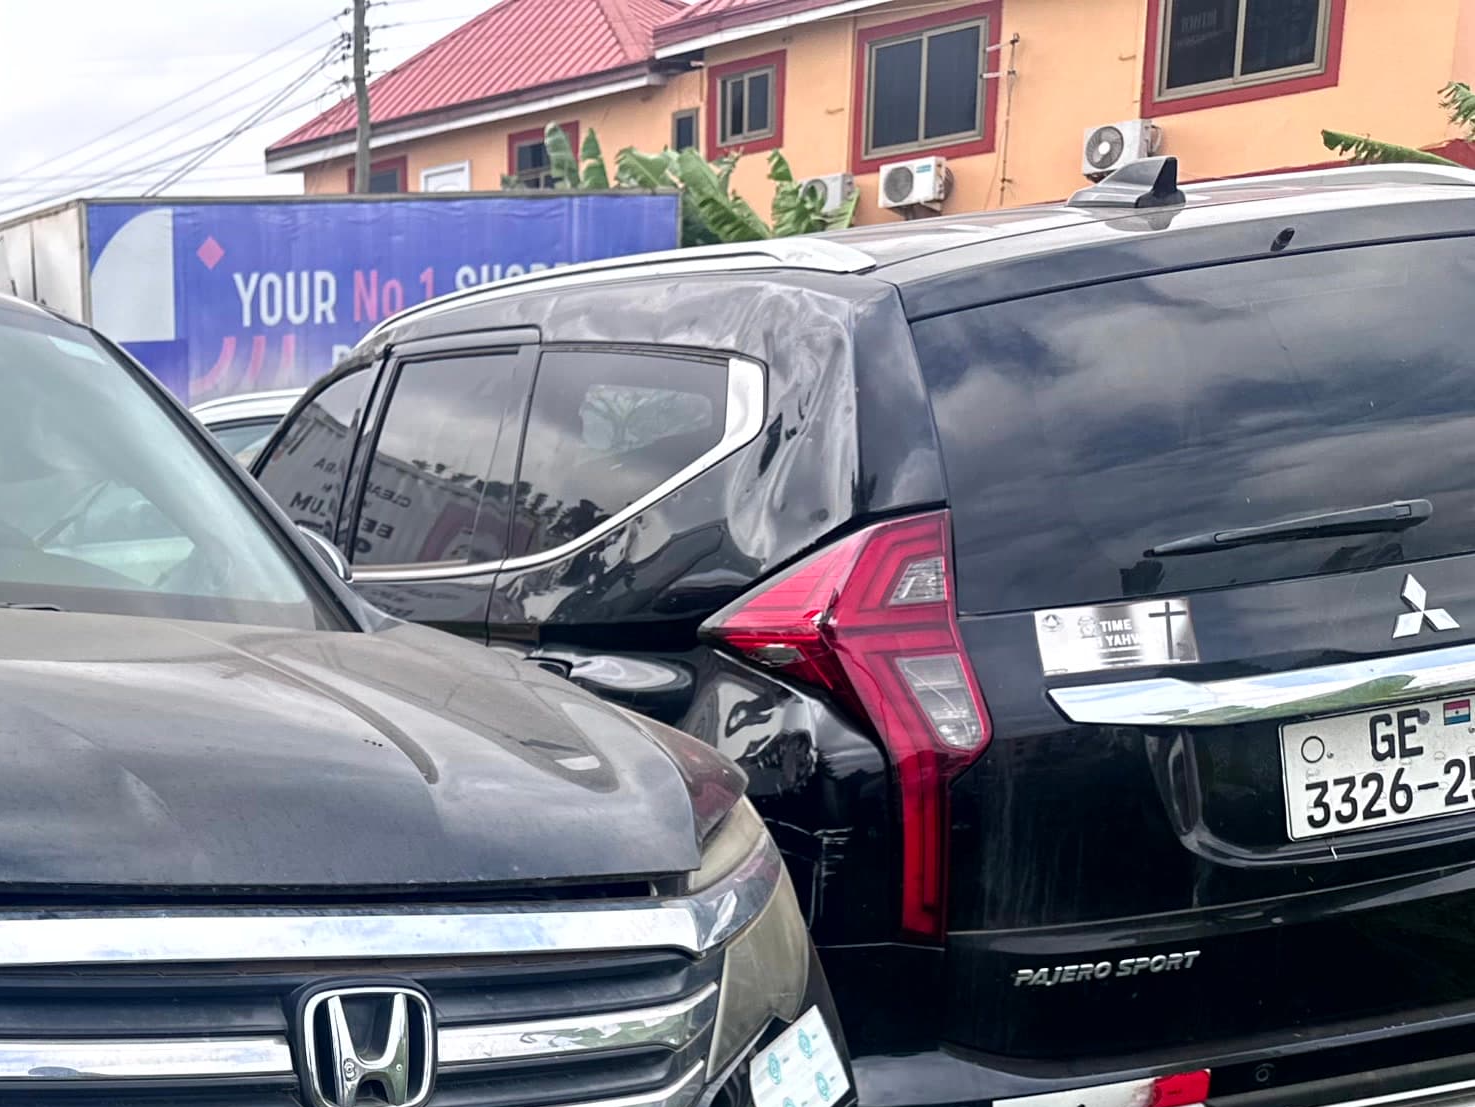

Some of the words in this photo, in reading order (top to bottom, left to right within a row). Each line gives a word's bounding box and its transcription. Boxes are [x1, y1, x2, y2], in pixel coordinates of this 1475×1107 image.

[233, 271, 337, 326] YOUR
[1099, 619, 1133, 632] TIME
[1369, 708, 1424, 762] GE
[1014, 961, 1112, 986] PAJERO
[1116, 950, 1201, 977] SPORT
